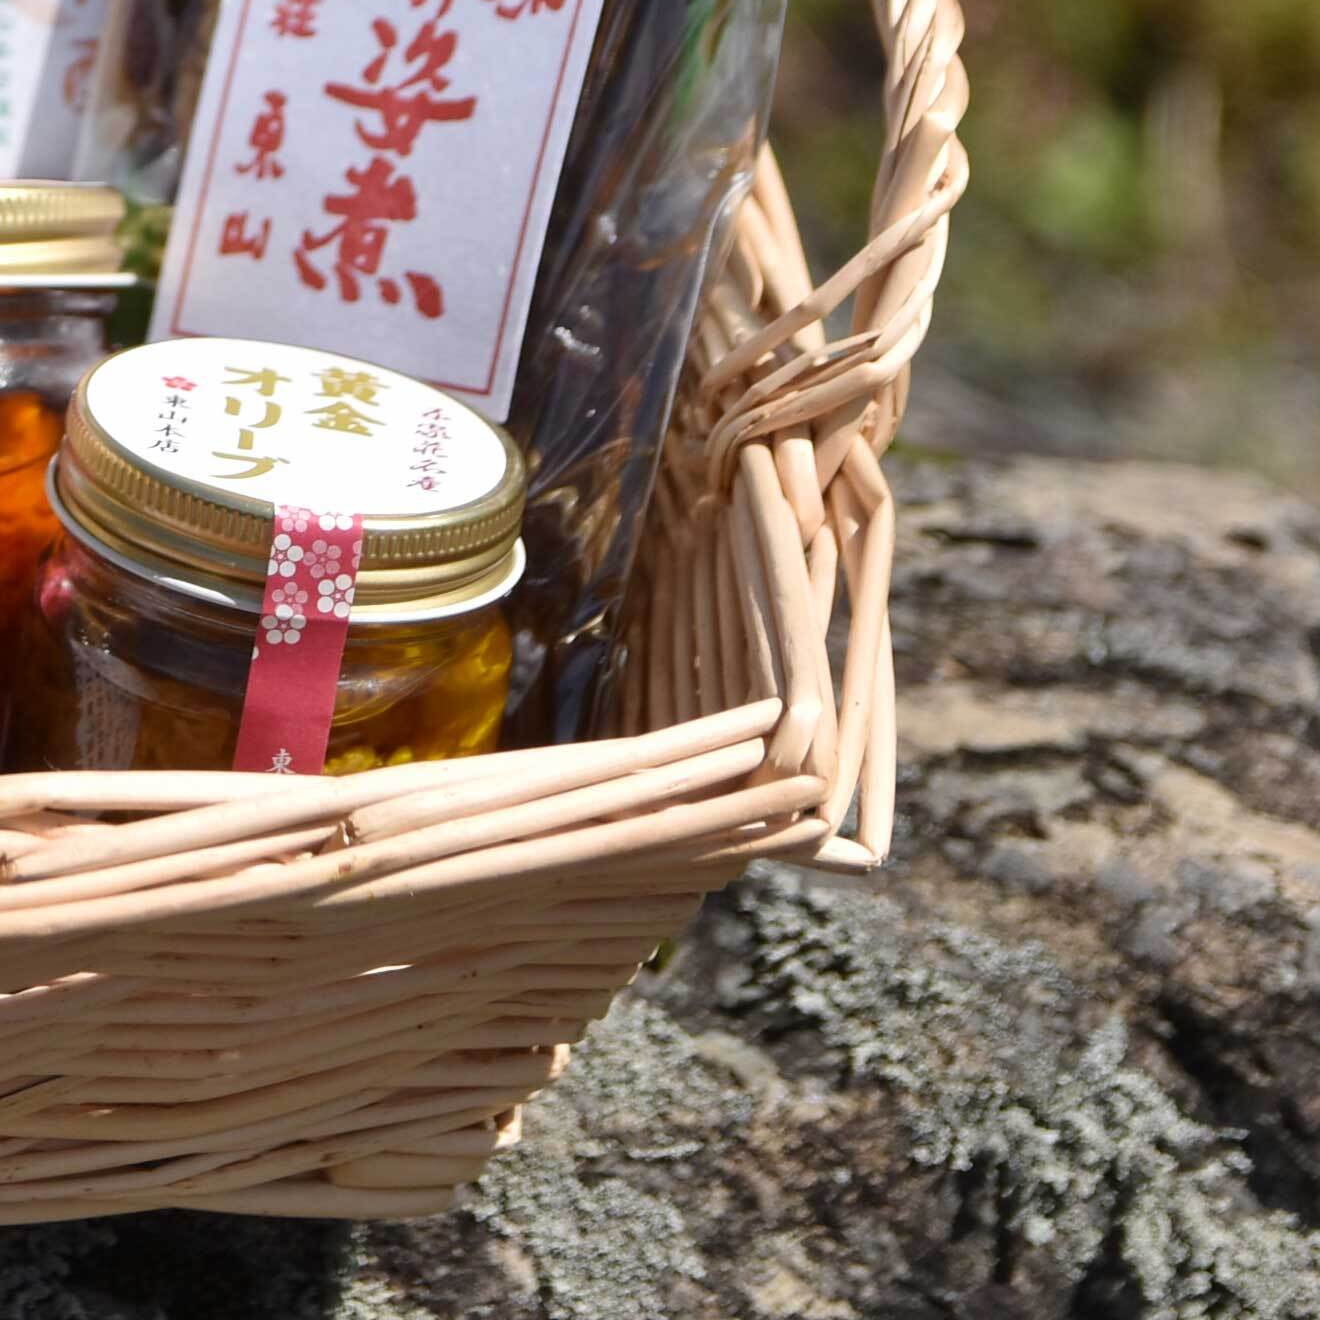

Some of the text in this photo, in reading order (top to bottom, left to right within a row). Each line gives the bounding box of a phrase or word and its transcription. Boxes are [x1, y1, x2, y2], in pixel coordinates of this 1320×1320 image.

[210, 365, 293, 480] オリーブ
[303, 366, 387, 437] 黄金
